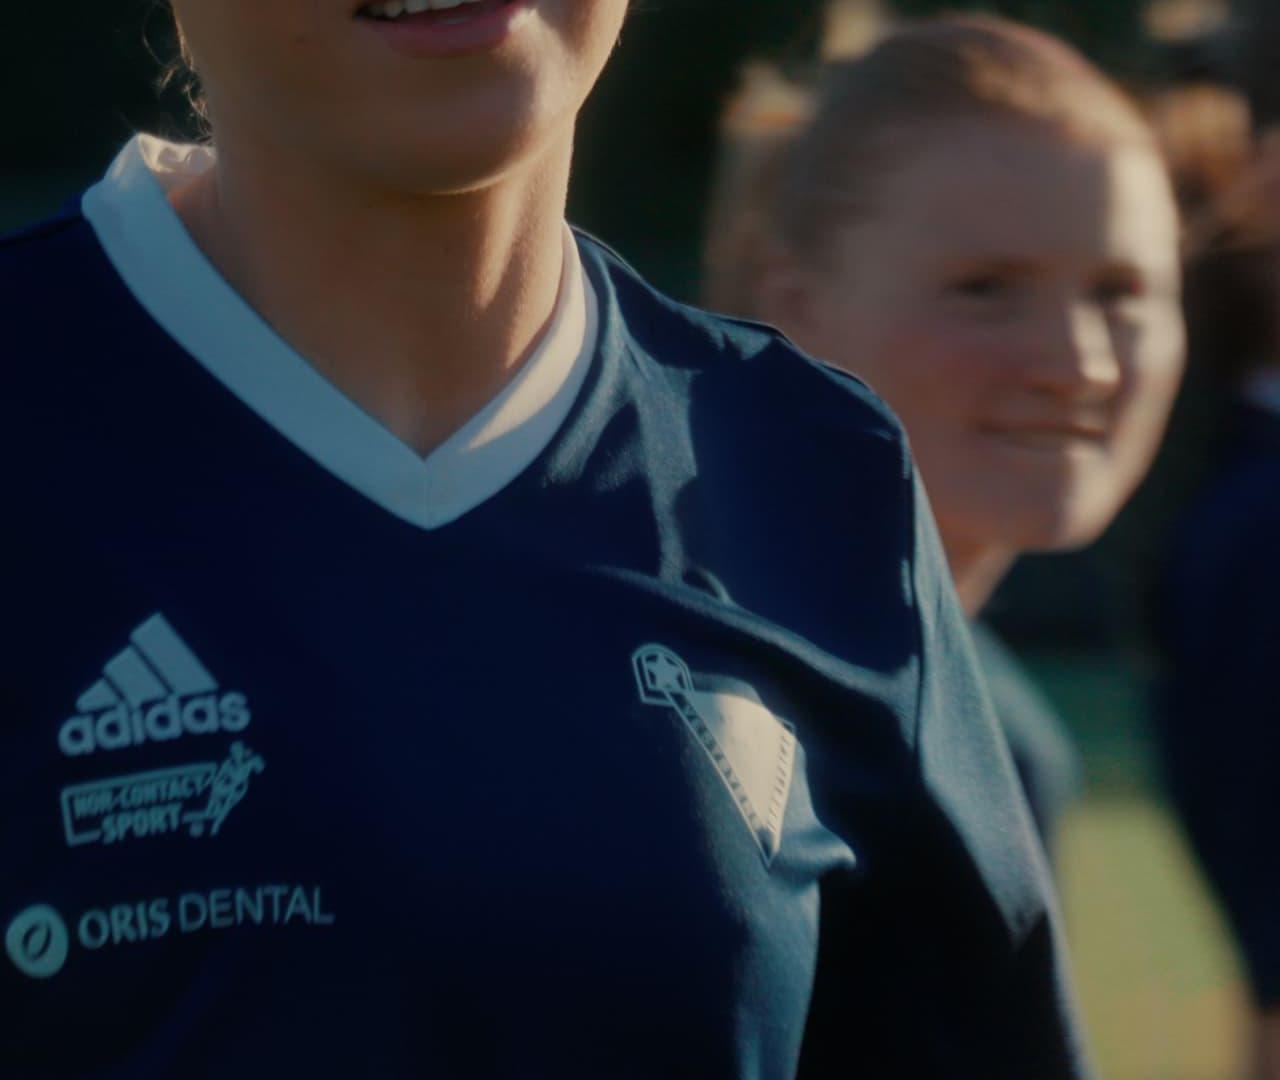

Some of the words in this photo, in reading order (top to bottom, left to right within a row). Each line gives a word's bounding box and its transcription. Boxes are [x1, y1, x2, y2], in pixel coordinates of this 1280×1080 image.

[57, 690, 251, 756] adidas
[101, 802, 183, 845] SPORT
[77, 897, 171, 950] ORIS
[178, 885, 336, 934] DENTAL
